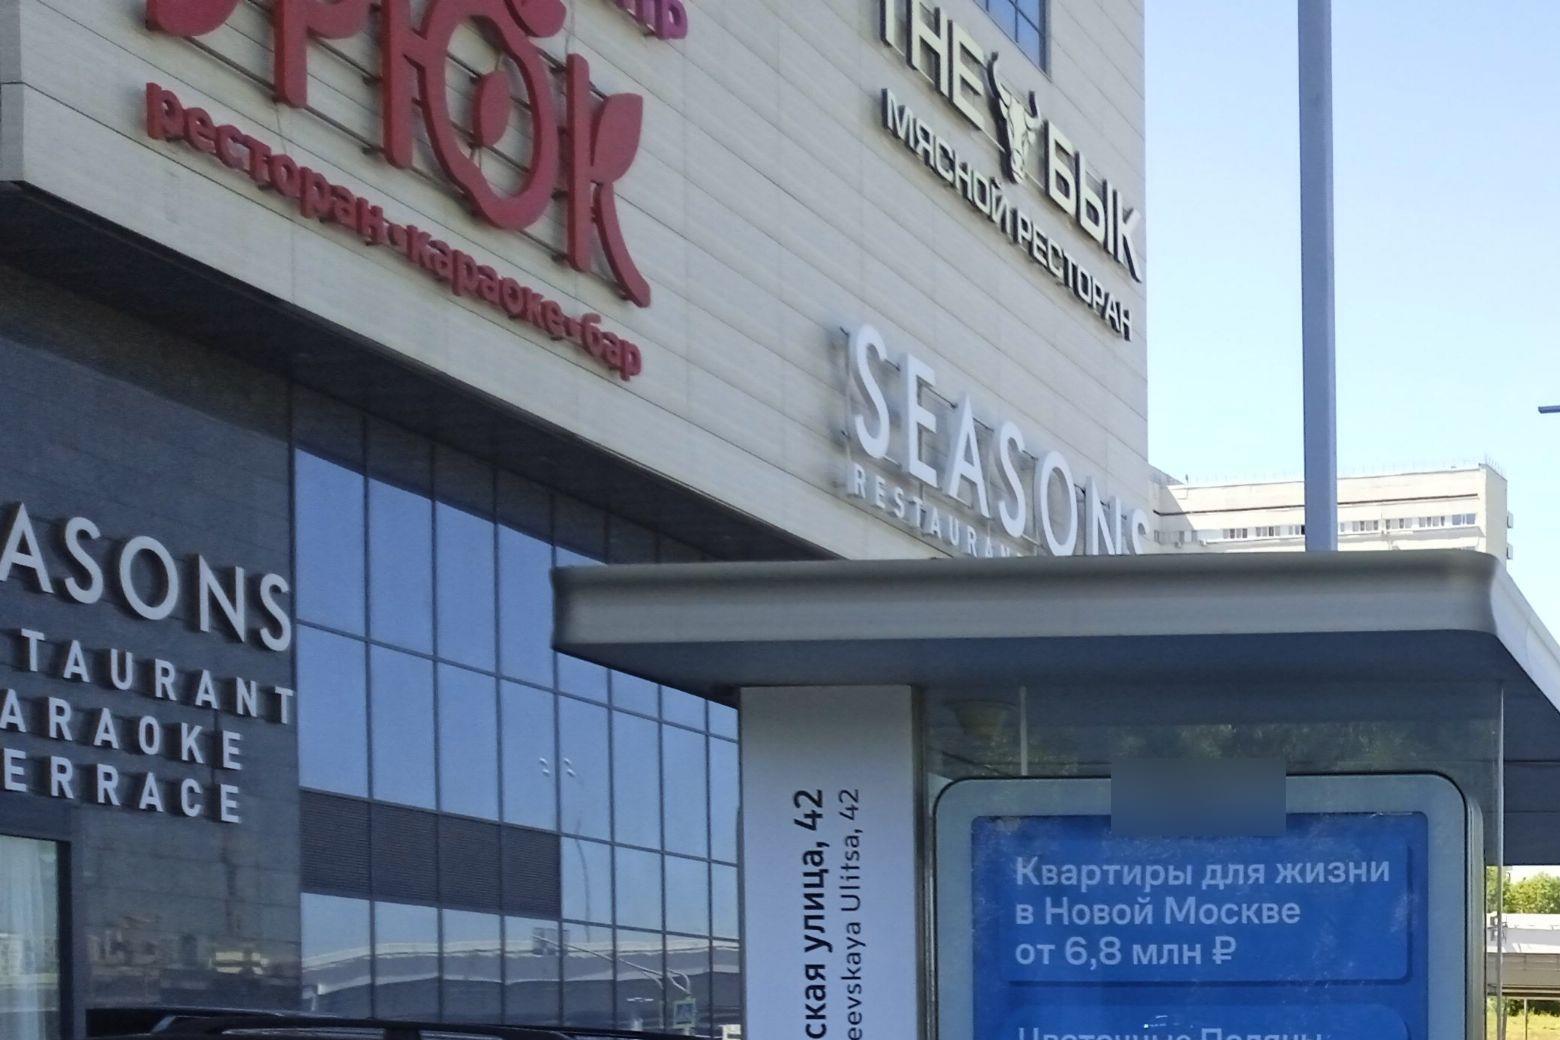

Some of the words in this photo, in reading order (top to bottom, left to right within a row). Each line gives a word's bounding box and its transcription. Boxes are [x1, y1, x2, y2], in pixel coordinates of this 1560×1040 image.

[146, 82, 384, 246] ресторан
[407, 224, 566, 341] караоке
[579, 312, 642, 382] бар
[881, 88, 1012, 243] МЯСНОЙ
[1014, 209, 1132, 341] РЕСТОРАН
[1043, 119, 1142, 282] БЫК
[794, 788, 823, 832] 42
[839, 788, 860, 823] 42
[802, 841, 833, 952] улица,
[839, 829, 864, 912] Ulitsa,
[1015, 856, 1193, 893] Квартиры
[1202, 860, 1266, 889] для
[1275, 859, 1390, 884] жизни
[1015, 903, 1034, 925] в
[1045, 896, 1153, 926] Новой
[1165, 896, 1302, 926] Москве
[1015, 943, 1056, 965] от
[1064, 936, 1122, 971] 6,8
[1132, 942, 1201, 965] млн
